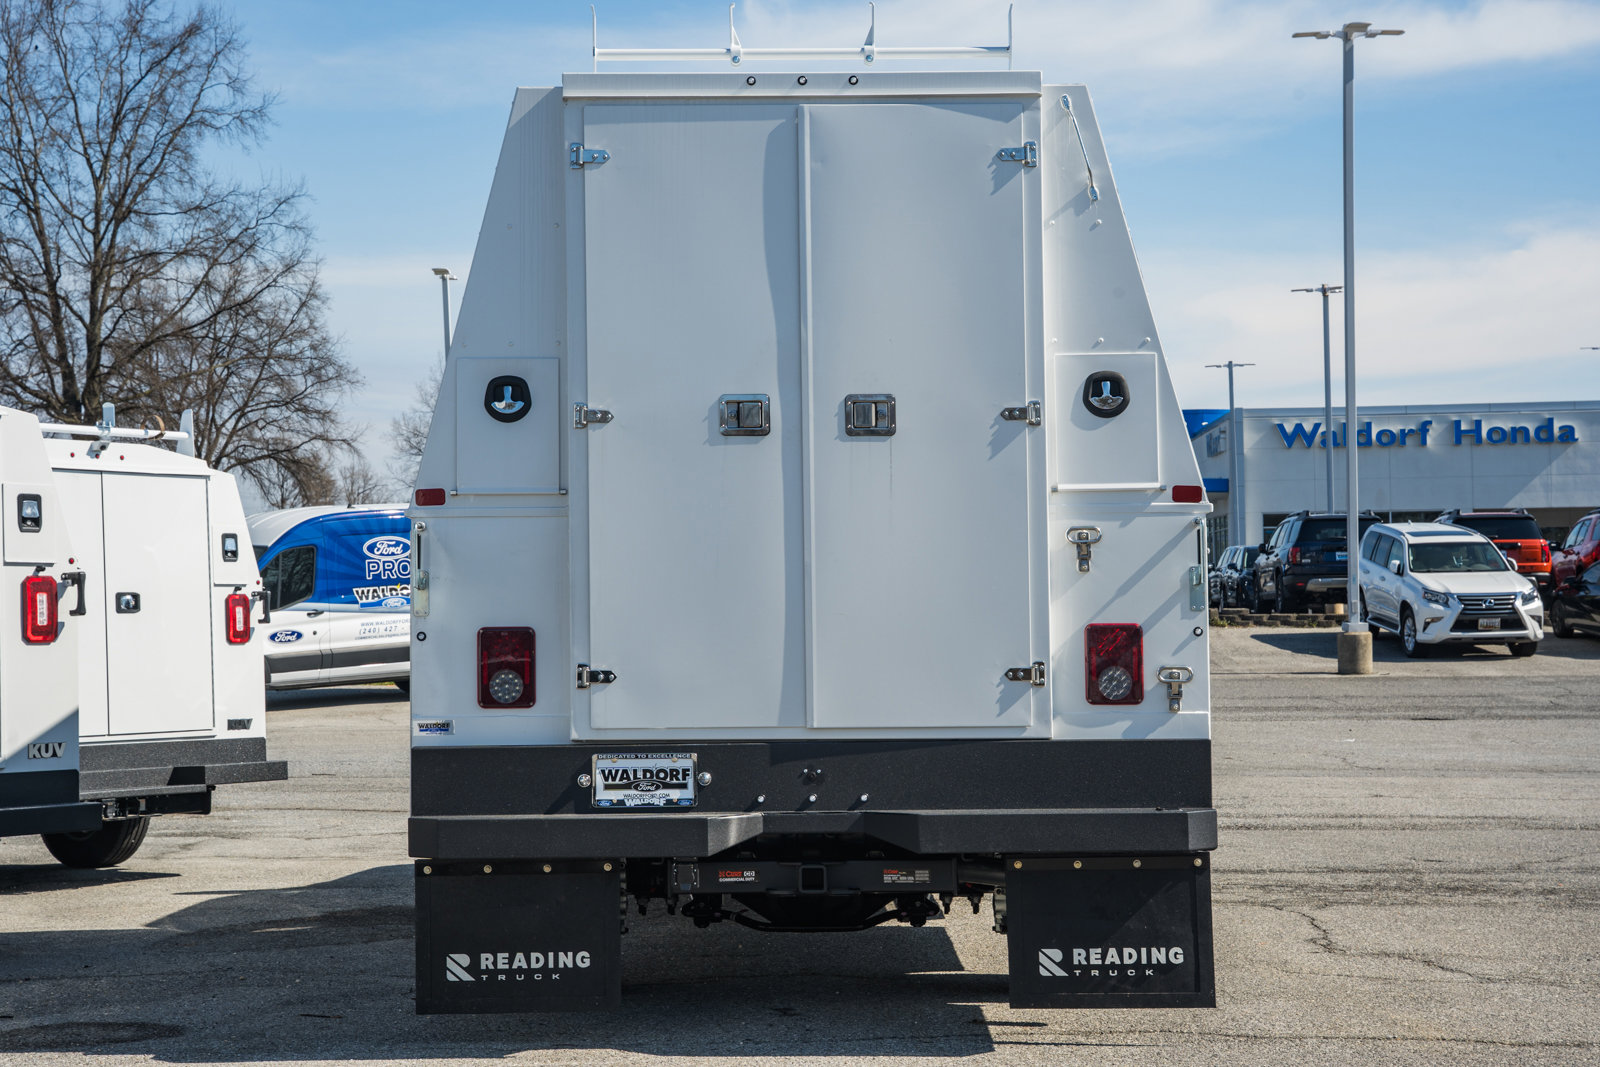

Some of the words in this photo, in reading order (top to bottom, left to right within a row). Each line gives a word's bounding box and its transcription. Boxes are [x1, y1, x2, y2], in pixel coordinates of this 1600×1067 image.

[1276, 420, 1433, 448] Waldorf
[1453, 417, 1579, 445] Honda
[373, 540, 404, 555] Ford
[365, 558, 411, 580] PRO
[274, 631, 298, 642] Ford
[359, 626, 380, 635] (240)
[227, 719, 253, 731] KUV
[28, 742, 66, 759] KUV
[600, 768, 691, 782] WALDORF
[637, 782, 657, 791] Ford
[624, 798, 667, 807] WALDORF
[480, 951, 591, 970] READING
[1073, 947, 1184, 965] READING
[480, 973, 560, 981] TRUCK
[1074, 969, 1154, 977] TRUCK
